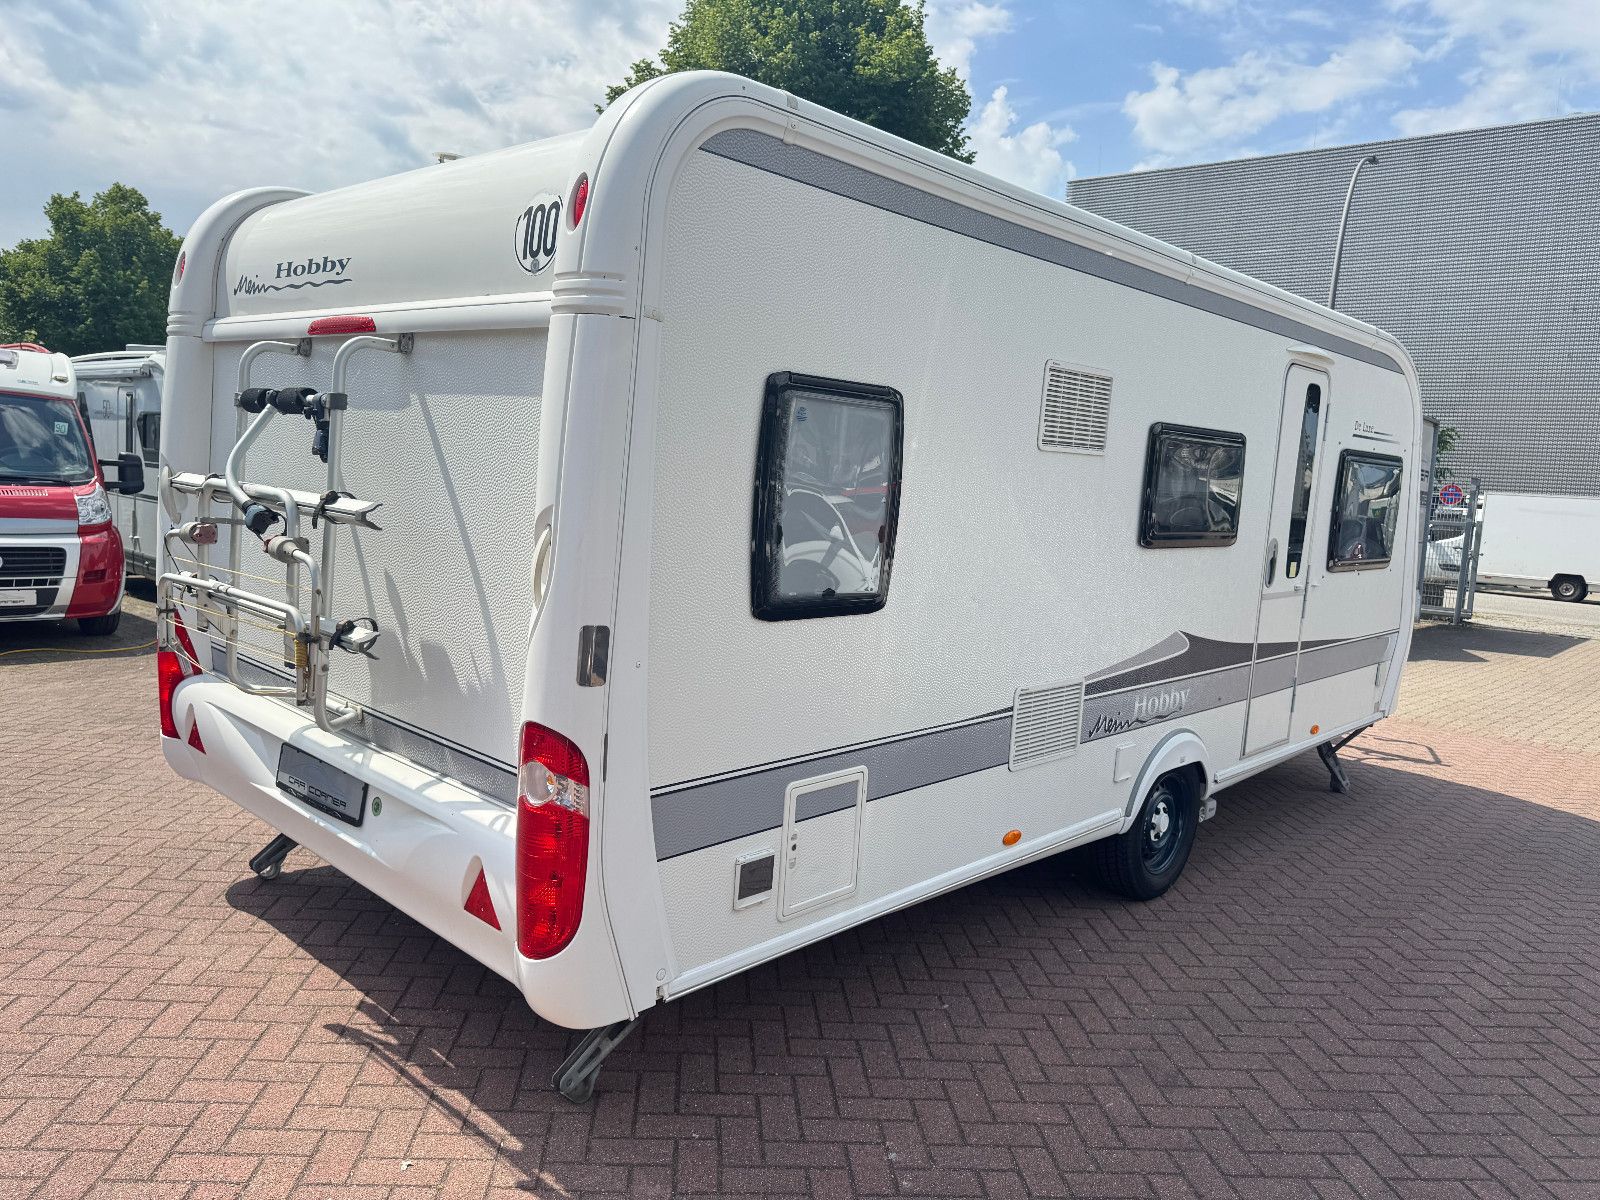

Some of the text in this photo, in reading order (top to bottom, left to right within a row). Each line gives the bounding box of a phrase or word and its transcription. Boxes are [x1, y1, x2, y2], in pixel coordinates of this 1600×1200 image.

[522, 200, 560, 260] 100
[233, 256, 352, 296] Mein Hobby
[1088, 687, 1191, 738] Mein Hobby
[288, 775, 306, 790] CAR
[308, 785, 347, 811] CORNER
